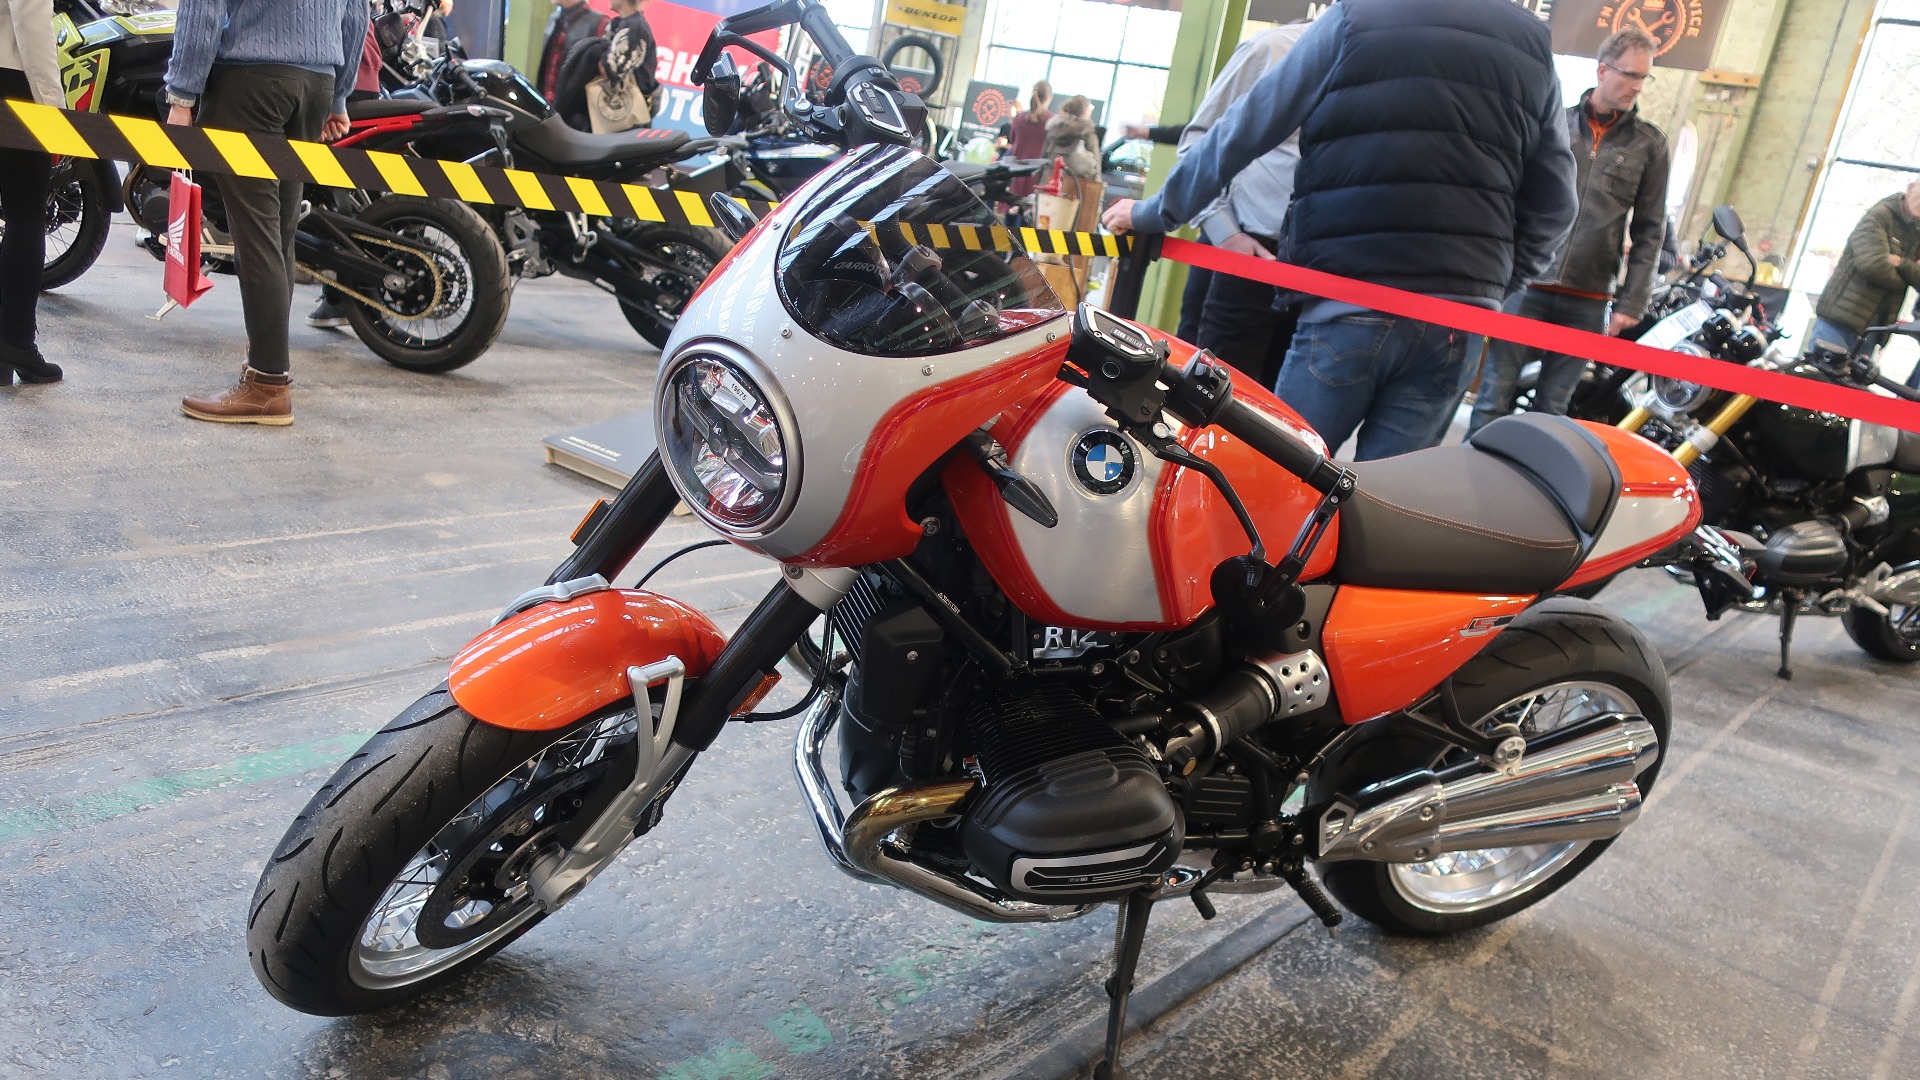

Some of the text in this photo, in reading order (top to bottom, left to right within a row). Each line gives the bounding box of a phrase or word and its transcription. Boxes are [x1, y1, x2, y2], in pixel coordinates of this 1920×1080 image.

[904, 7, 958, 22] DUNLOP
[167, 244, 184, 266] HONDA
[1080, 434, 1130, 455] BMW
